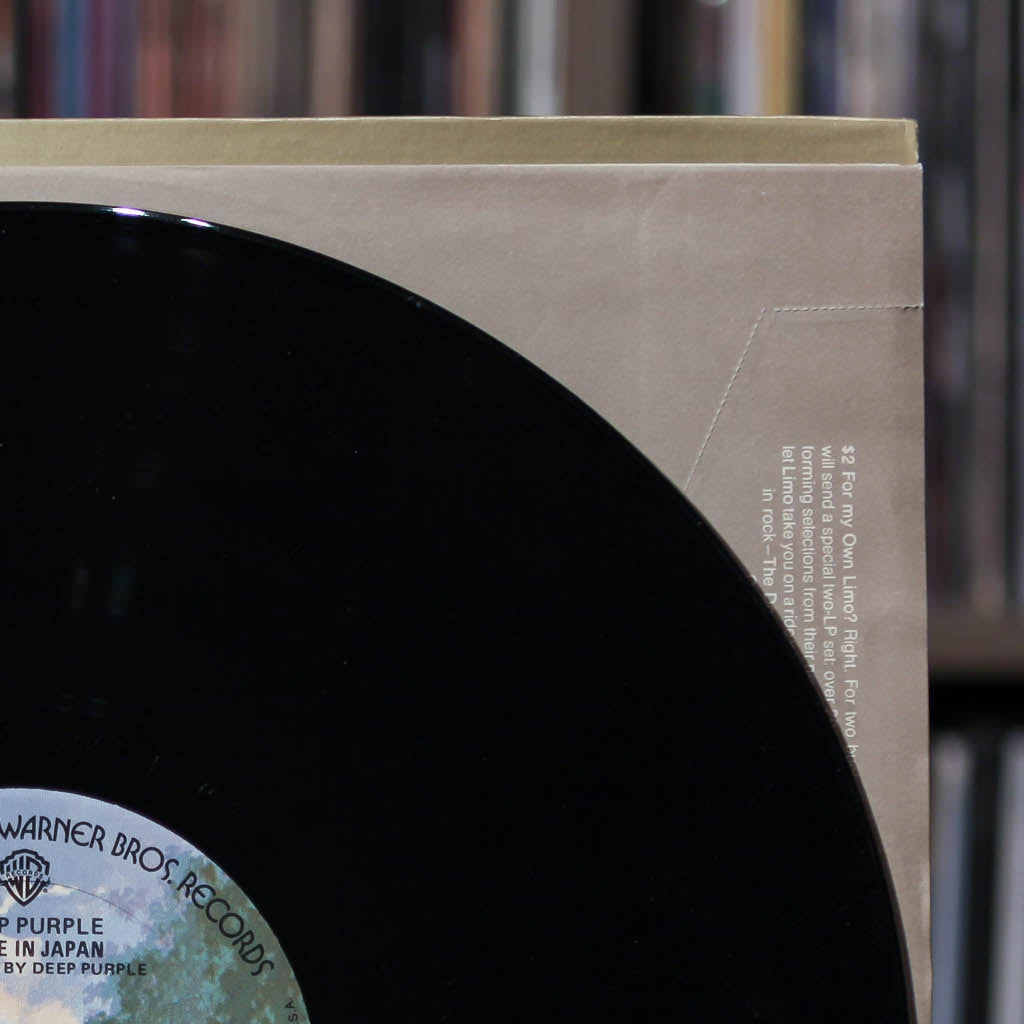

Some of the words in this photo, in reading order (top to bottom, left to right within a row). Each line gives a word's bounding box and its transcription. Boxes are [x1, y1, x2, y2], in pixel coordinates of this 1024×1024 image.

[782, 446, 796, 463] let
[821, 445, 836, 469] will
[840, 445, 856, 465] $2
[782, 466, 797, 505] Limo
[799, 446, 815, 504] forming
[841, 472, 856, 498] For
[762, 488, 776, 502] in
[821, 473, 836, 509] send
[782, 508, 796, 539] take
[821, 513, 833, 522] a
[839, 504, 854, 528] my
[780, 543, 795, 570] you
[801, 508, 817, 583] selections
[820, 528, 836, 579] special
[842, 533, 857, 569] Own
[783, 574, 795, 593] on
[783, 597, 795, 605] a
[802, 588, 817, 623] from
[823, 584, 837, 637] two-LP
[842, 575, 858, 623] Limo?
[803, 627, 817, 661] their
[840, 629, 859, 672] Right.
[824, 671, 836, 704] over
[844, 679, 859, 704] For
[844, 712, 857, 738] two
[111, 832, 179, 885] BROS.
[177, 871, 275, 977] RECORDS
[16, 917, 104, 935] PURPLE
[15, 940, 35, 958] IN
[41, 940, 104, 958] JAPAN
[4, 961, 27, 974] BY
[32, 962, 76, 975] DEEP
[81, 963, 148, 976] PURPLE
